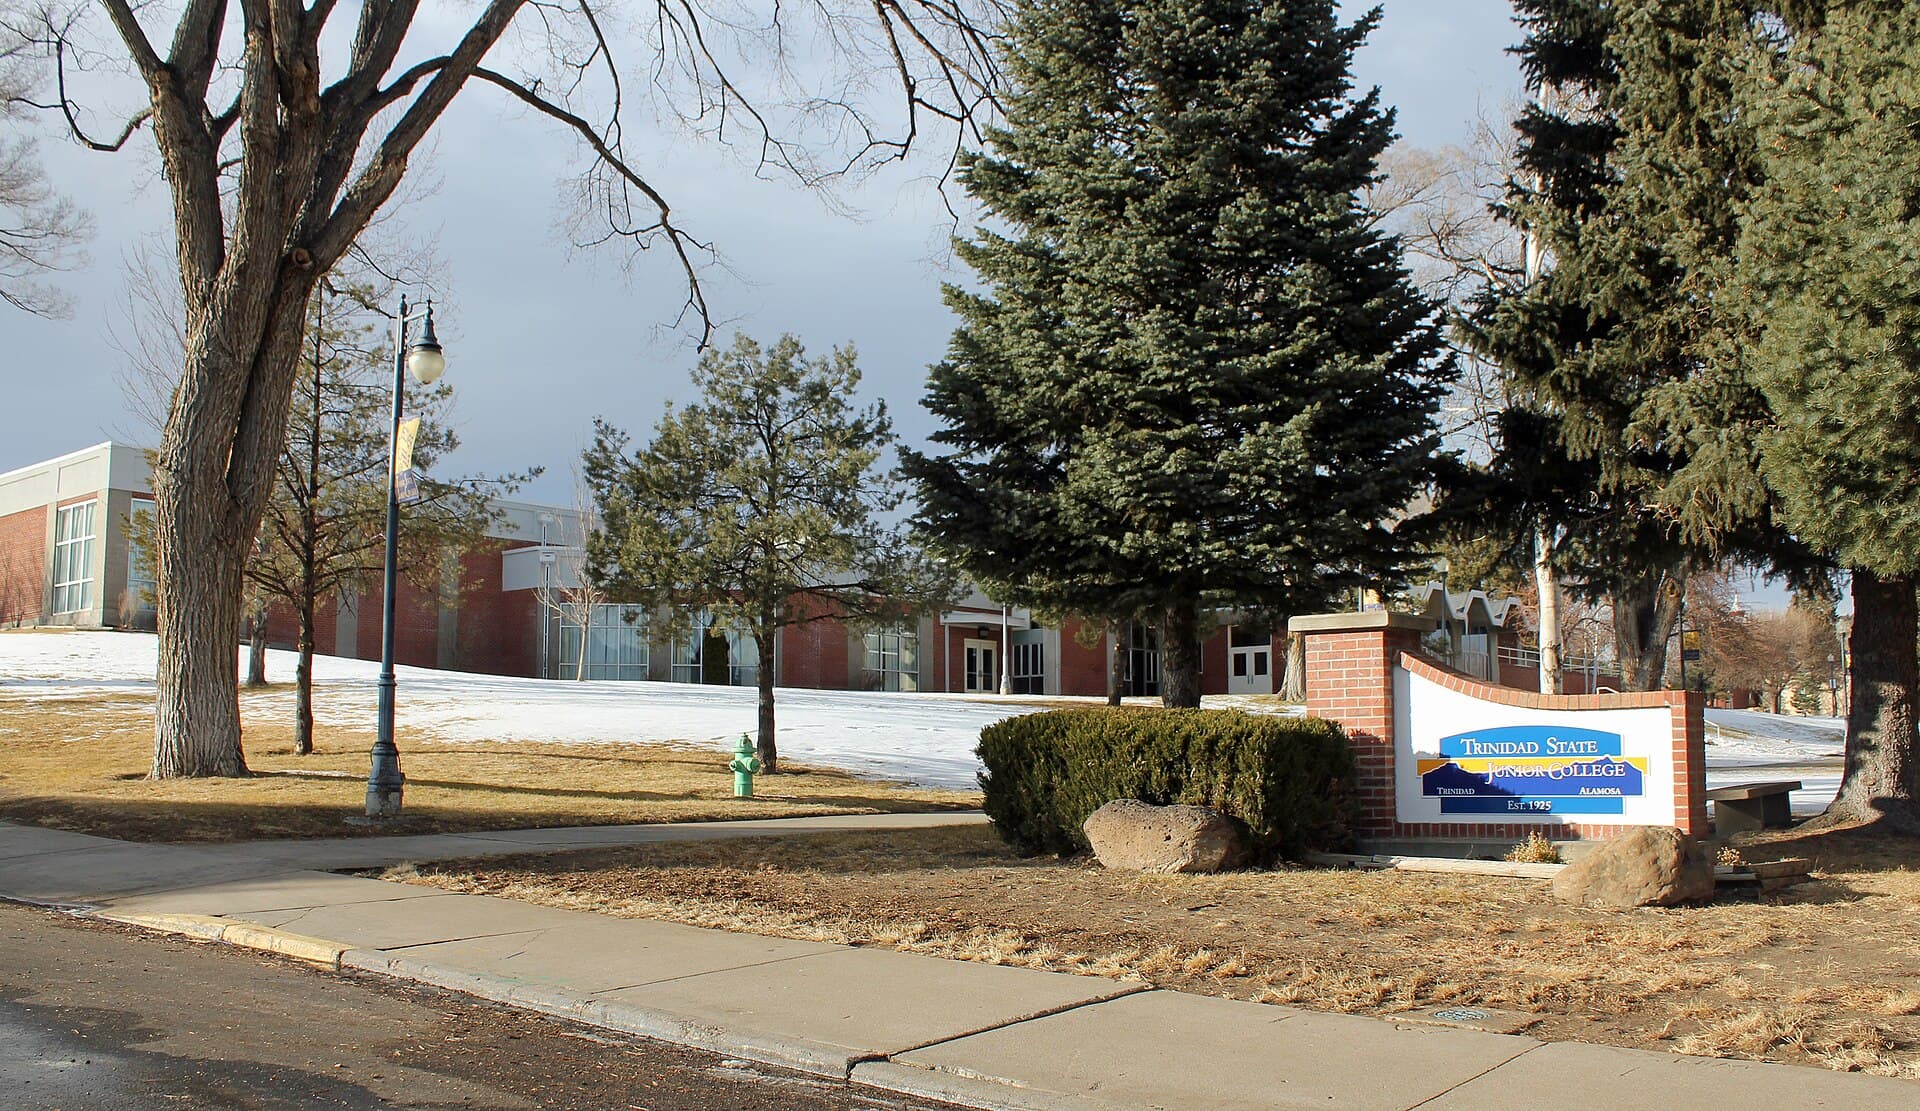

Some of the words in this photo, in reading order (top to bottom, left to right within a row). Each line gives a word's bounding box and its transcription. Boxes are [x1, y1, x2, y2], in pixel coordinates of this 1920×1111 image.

[1460, 738, 1538, 755] TRINIDAD
[1546, 737, 1597, 754] STATE
[1484, 762, 1546, 784] JUNIOR
[1547, 762, 1626, 780] COLLEGE
[1437, 787, 1475, 795] TRINIDAD
[1579, 786, 1621, 795] ALAMOSA
[1528, 800, 1552, 811] 1925
